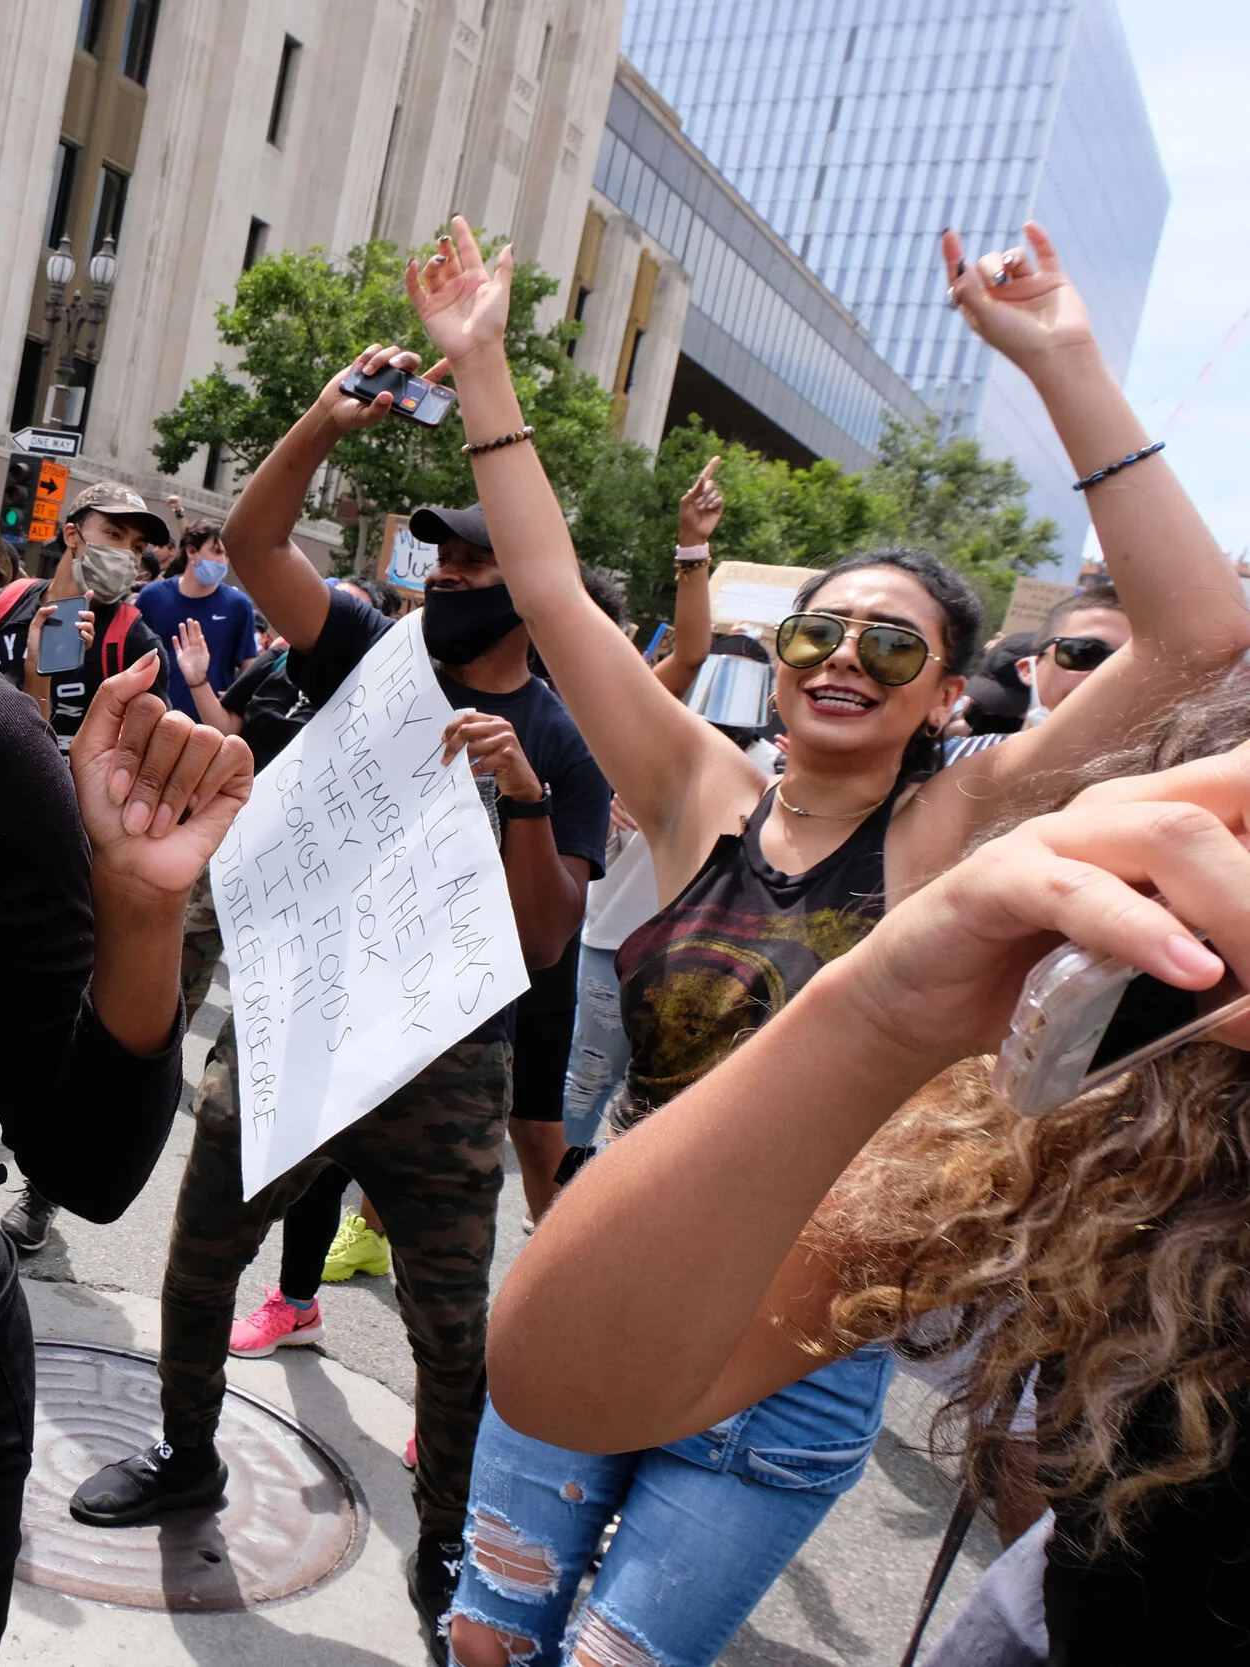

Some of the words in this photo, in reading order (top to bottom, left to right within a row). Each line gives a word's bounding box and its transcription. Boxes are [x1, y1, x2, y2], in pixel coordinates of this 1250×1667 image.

[30, 437, 49, 447] ONE
[52, 440, 72, 450] WAY
[31, 526, 50, 537] ALT
[275, 759, 330, 892] GEORGE
[332, 684, 407, 883] REMEMBER
[374, 618, 432, 737] THEY
[411, 739, 460, 868] WILL
[437, 871, 495, 1015] ALWAYS
[313, 757, 363, 850] THEY
[351, 863, 388, 975] TOOK
[387, 865, 426, 955] THE
[401, 952, 434, 1035] DAY
